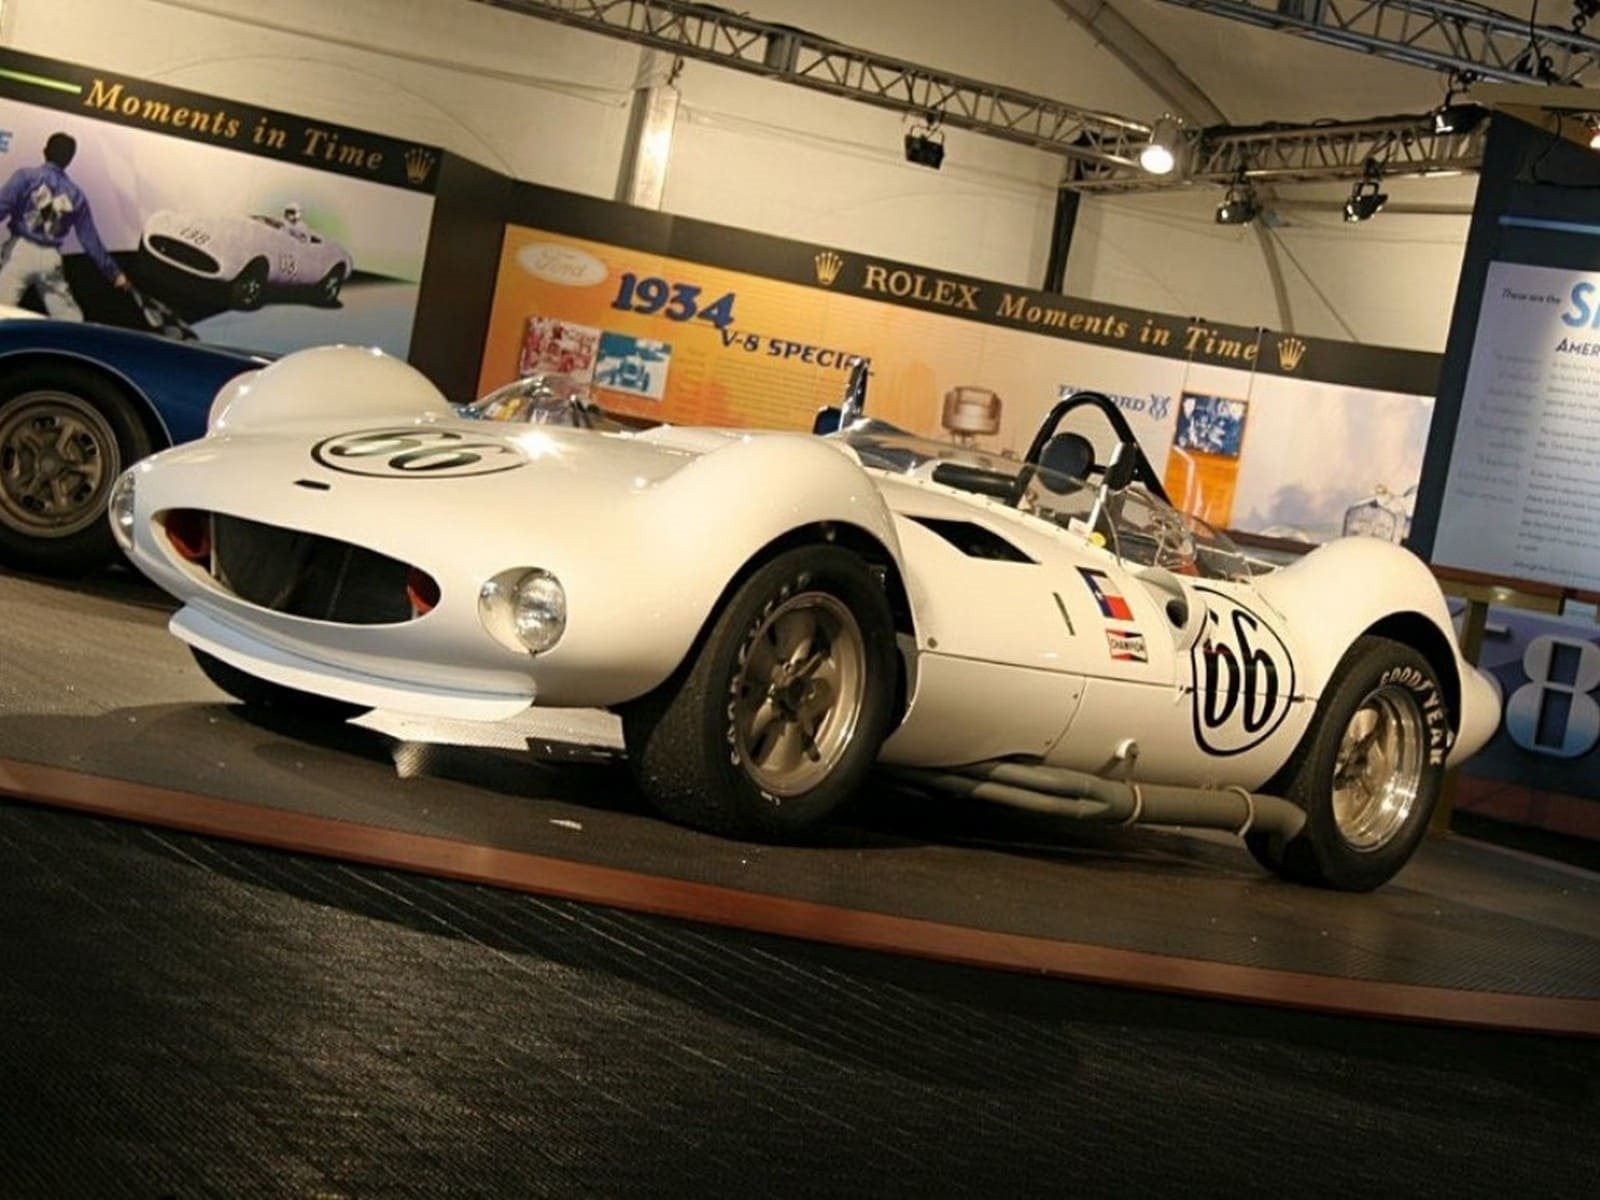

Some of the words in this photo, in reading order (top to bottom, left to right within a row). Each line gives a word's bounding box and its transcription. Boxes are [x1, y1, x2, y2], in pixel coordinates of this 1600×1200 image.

[83, 78, 240, 139] Moments
[252, 117, 287, 149] in
[302, 127, 384, 169] Time
[610, 272, 736, 329] 1934
[721, 328, 760, 352] V-8
[864, 265, 981, 311] ROLEX
[996, 293, 1129, 338] Moments
[1140, 319, 1170, 346] in
[1185, 325, 1260, 360] Time
[1203, 609, 1279, 733] 66
